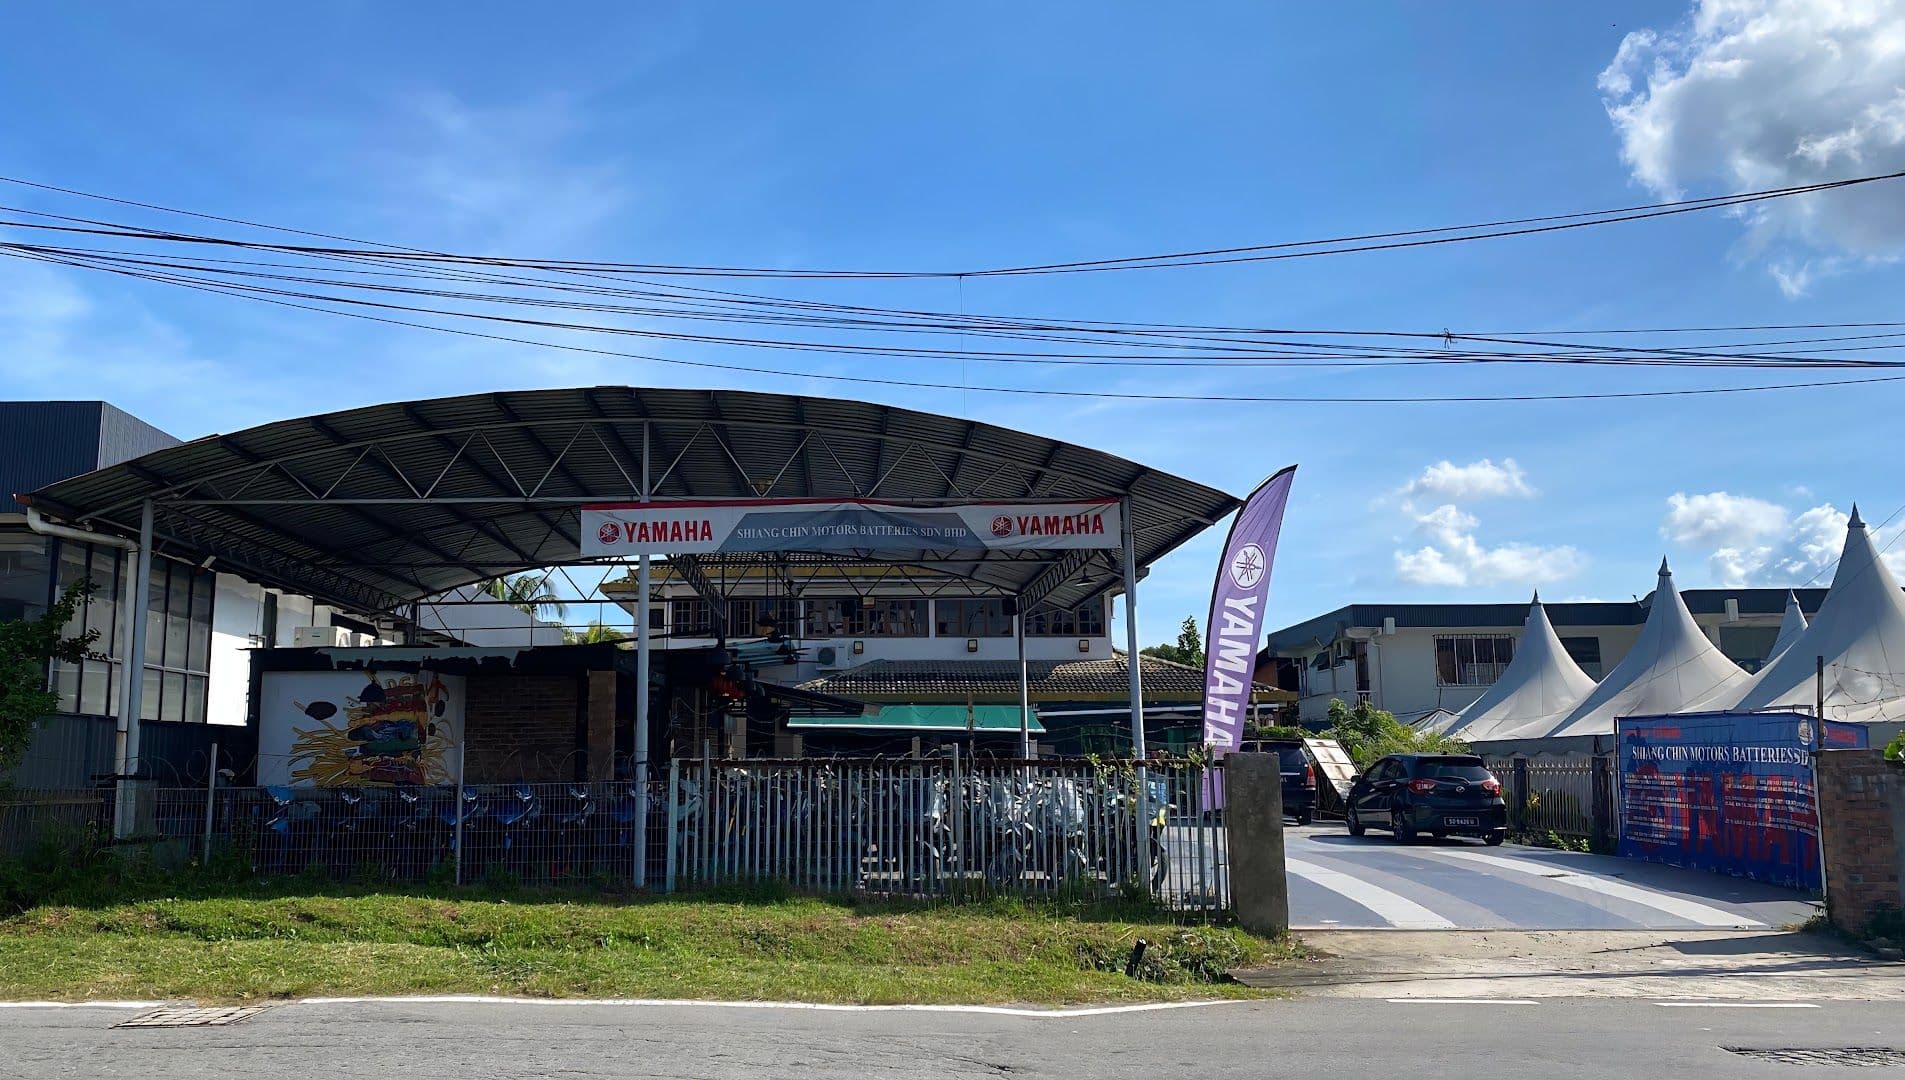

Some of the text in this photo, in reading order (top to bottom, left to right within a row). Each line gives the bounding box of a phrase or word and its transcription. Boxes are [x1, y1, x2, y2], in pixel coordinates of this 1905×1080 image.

[624, 520, 713, 543] YAMAHA
[737, 524, 967, 539] SHIANG CHIN MOTORS BATTERIES SDN BHD
[1016, 513, 1104, 536] YAMAHA
[1204, 596, 1258, 747] YAMAHA
[1632, 745, 1665, 761] SHIANG
[1665, 746, 1688, 761] CHIN
[1690, 746, 1730, 762] MOTORS
[1732, 747, 1794, 764] BATTERIES
